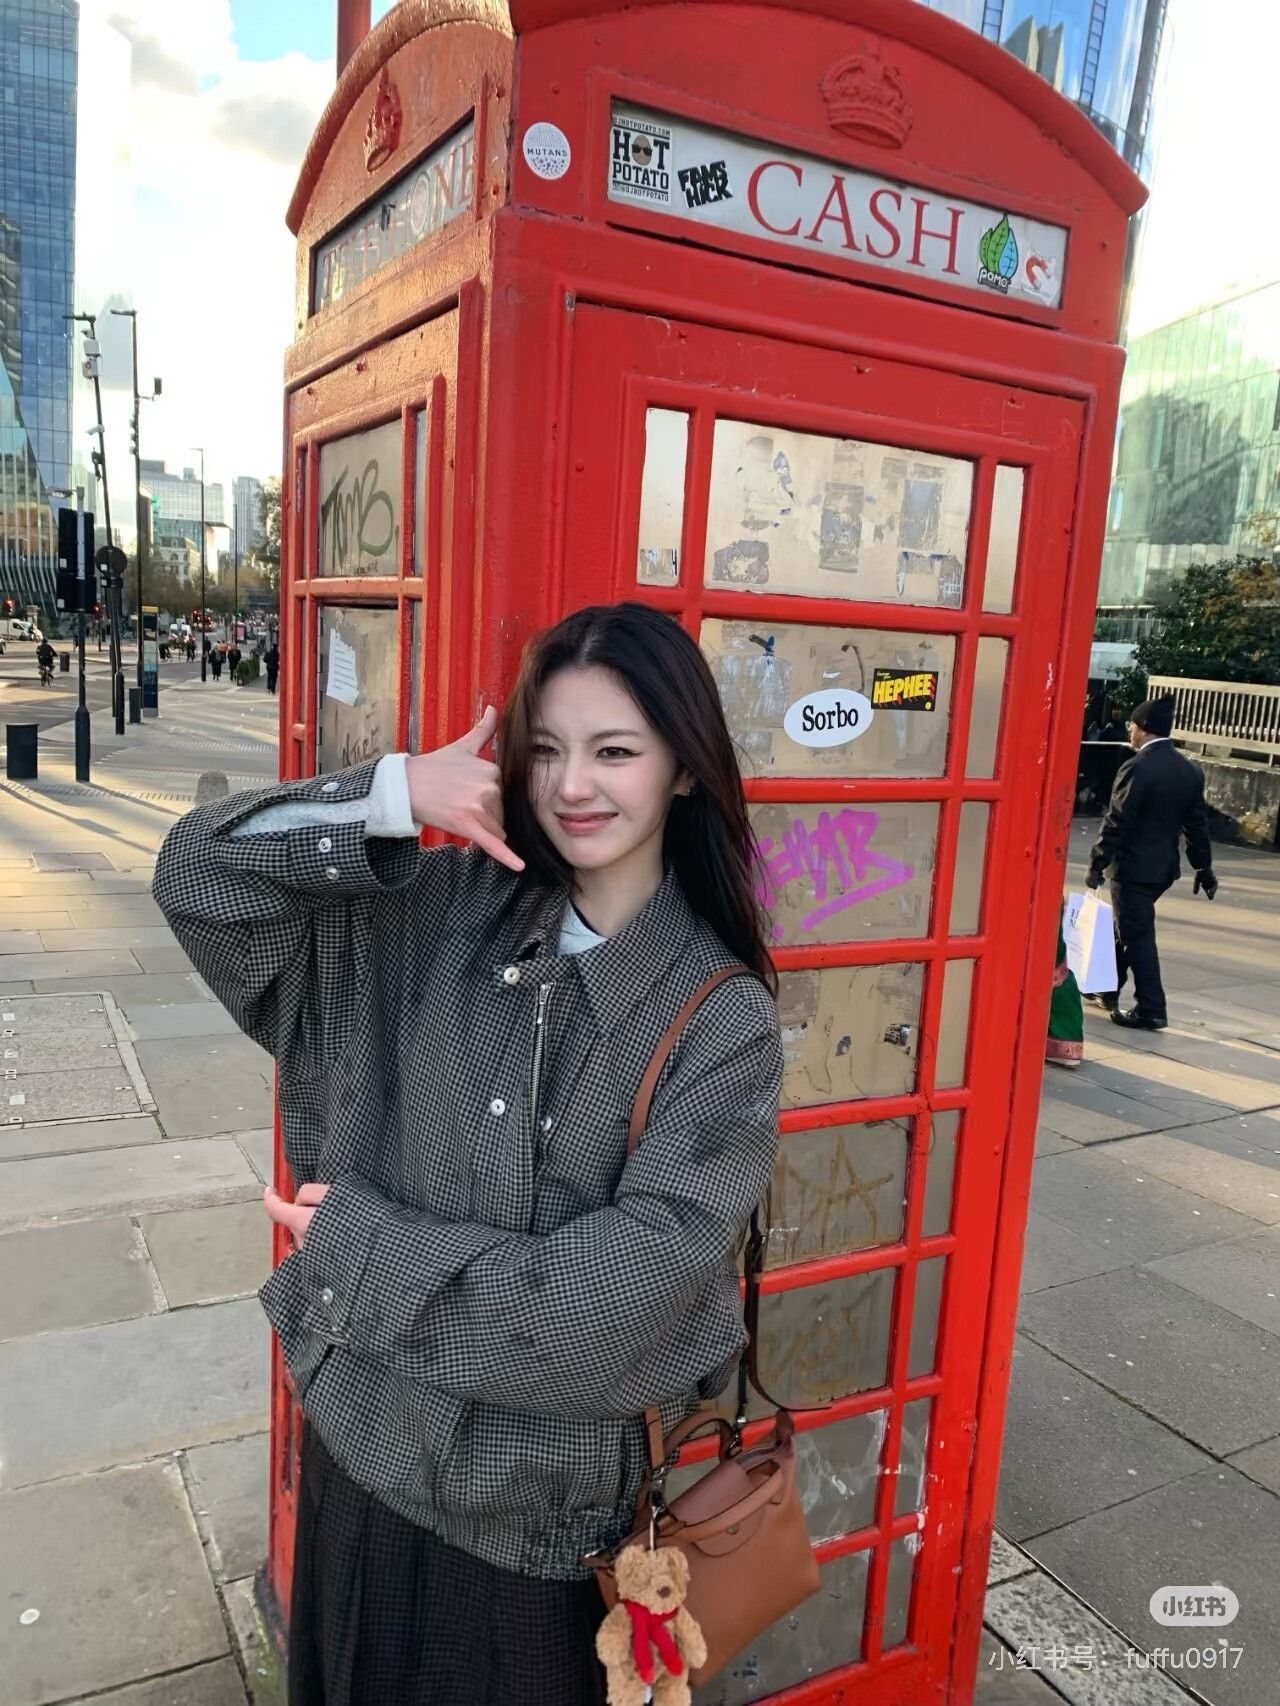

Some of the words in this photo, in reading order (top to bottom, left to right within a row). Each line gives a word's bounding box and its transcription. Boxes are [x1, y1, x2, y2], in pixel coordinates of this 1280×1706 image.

[527, 147, 567, 157] MUTANS
[612, 161, 669, 190] POTATO
[747, 160, 965, 275] CASH
[873, 673, 934, 704] HEPHEE
[802, 701, 859, 732] Sorbo
